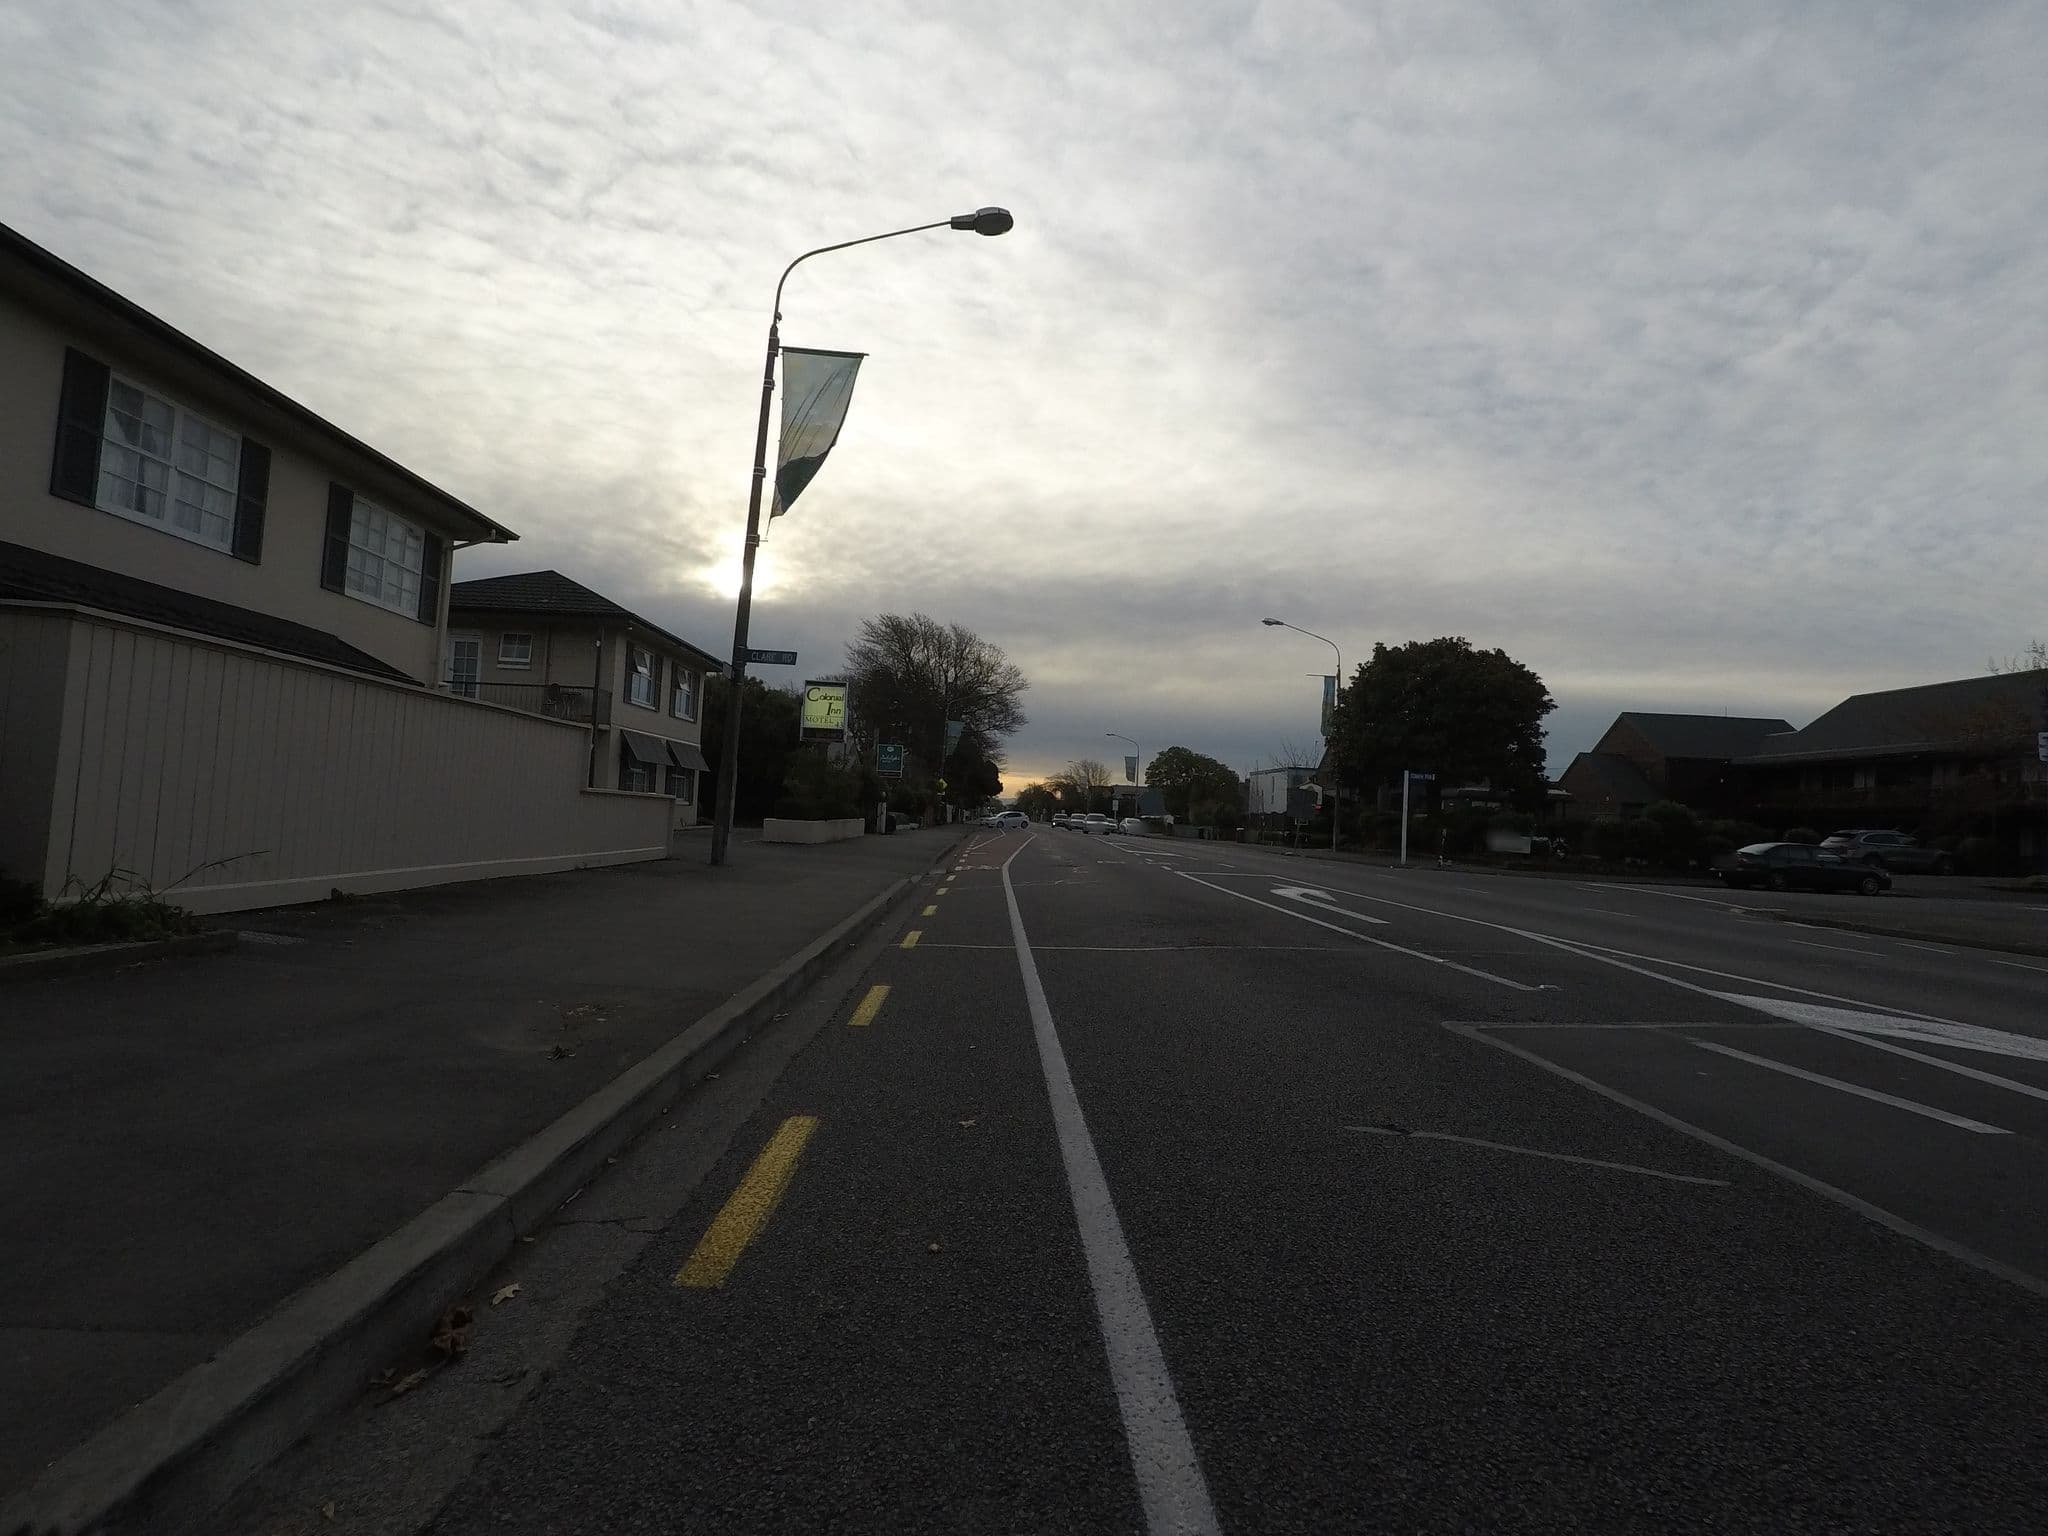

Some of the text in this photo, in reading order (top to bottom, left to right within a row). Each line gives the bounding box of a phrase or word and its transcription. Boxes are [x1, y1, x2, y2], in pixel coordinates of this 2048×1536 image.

[807, 687, 844, 702] Colonial
[827, 702, 841, 715] Inn
[805, 716, 834, 725] MOTEL
